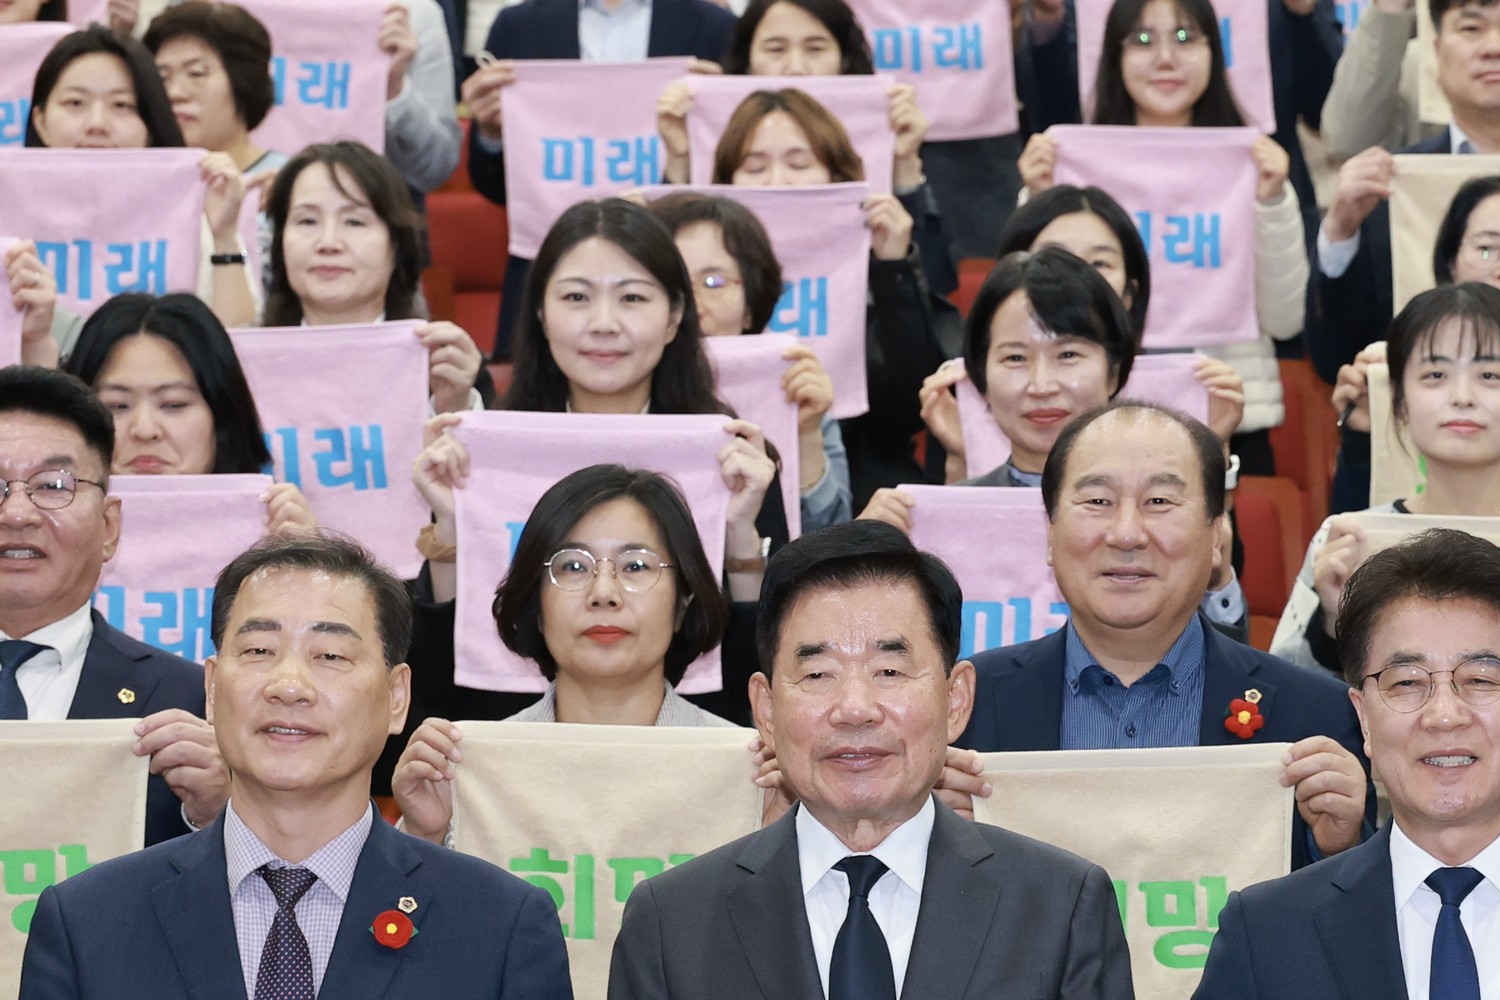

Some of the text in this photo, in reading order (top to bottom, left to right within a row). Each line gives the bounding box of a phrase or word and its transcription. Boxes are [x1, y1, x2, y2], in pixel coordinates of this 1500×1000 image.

[875, 22, 984, 73] 미래
[269, 57, 350, 110] 래
[541, 136, 660, 187] 미래
[1135, 211, 1222, 269] 래
[767, 277, 829, 337] 래
[957, 598, 1072, 660] 미
[0, 844, 97, 935] 망
[1112, 876, 1227, 969] 망
